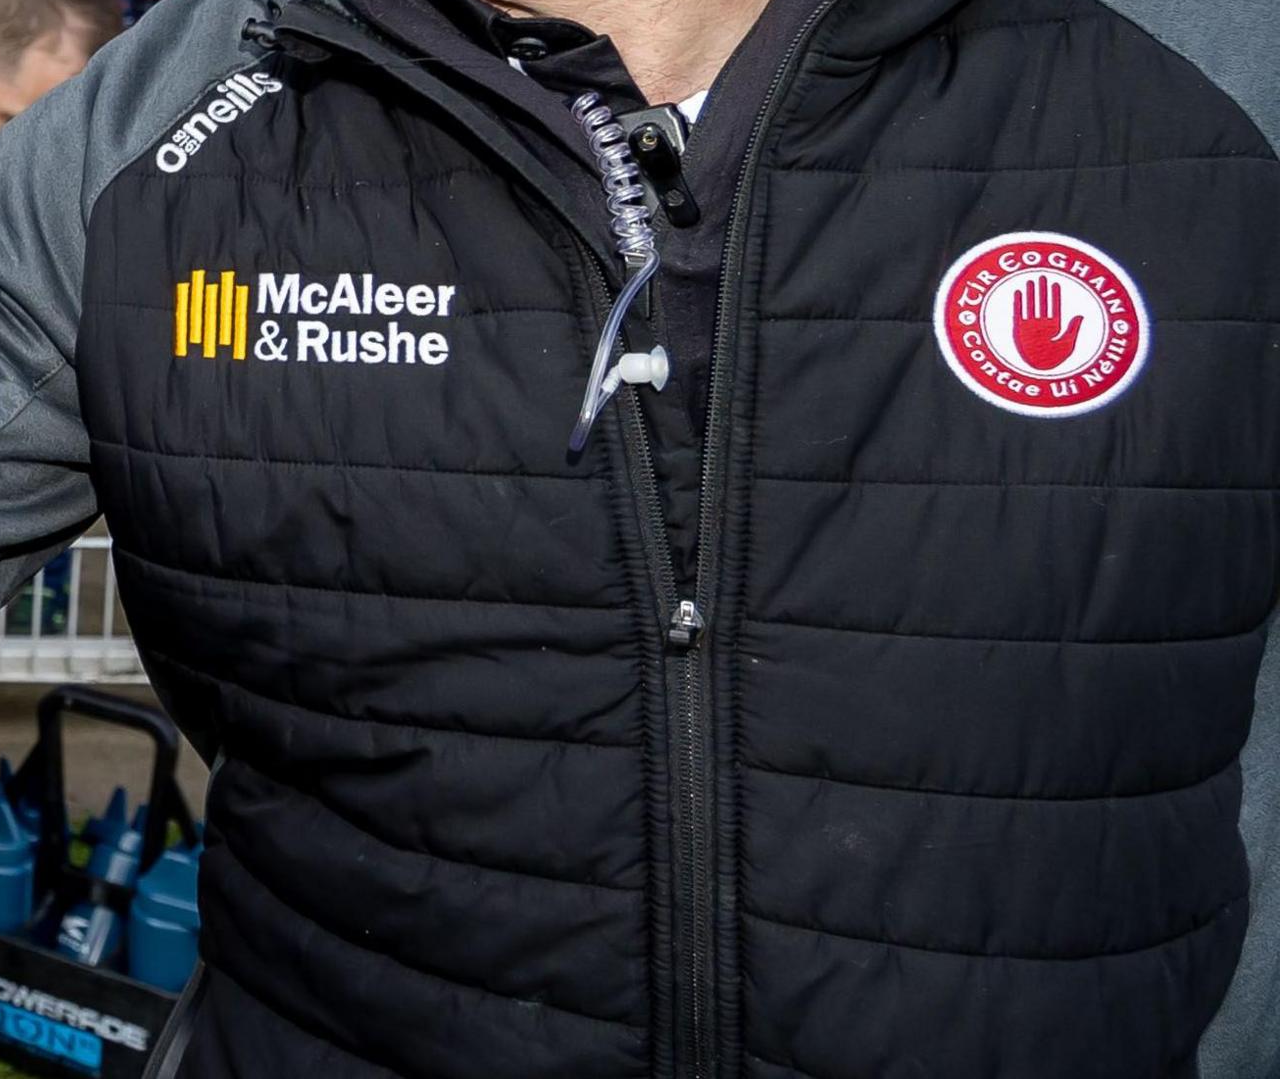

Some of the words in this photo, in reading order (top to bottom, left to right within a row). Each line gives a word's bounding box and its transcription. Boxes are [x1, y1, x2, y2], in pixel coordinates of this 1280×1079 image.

[256, 272, 456, 317] McAleer
[998, 250, 1127, 315] EOGHAIN
[253, 319, 288, 362] &
[296, 320, 450, 366] Rushe
[962, 330, 1041, 397] Contae
